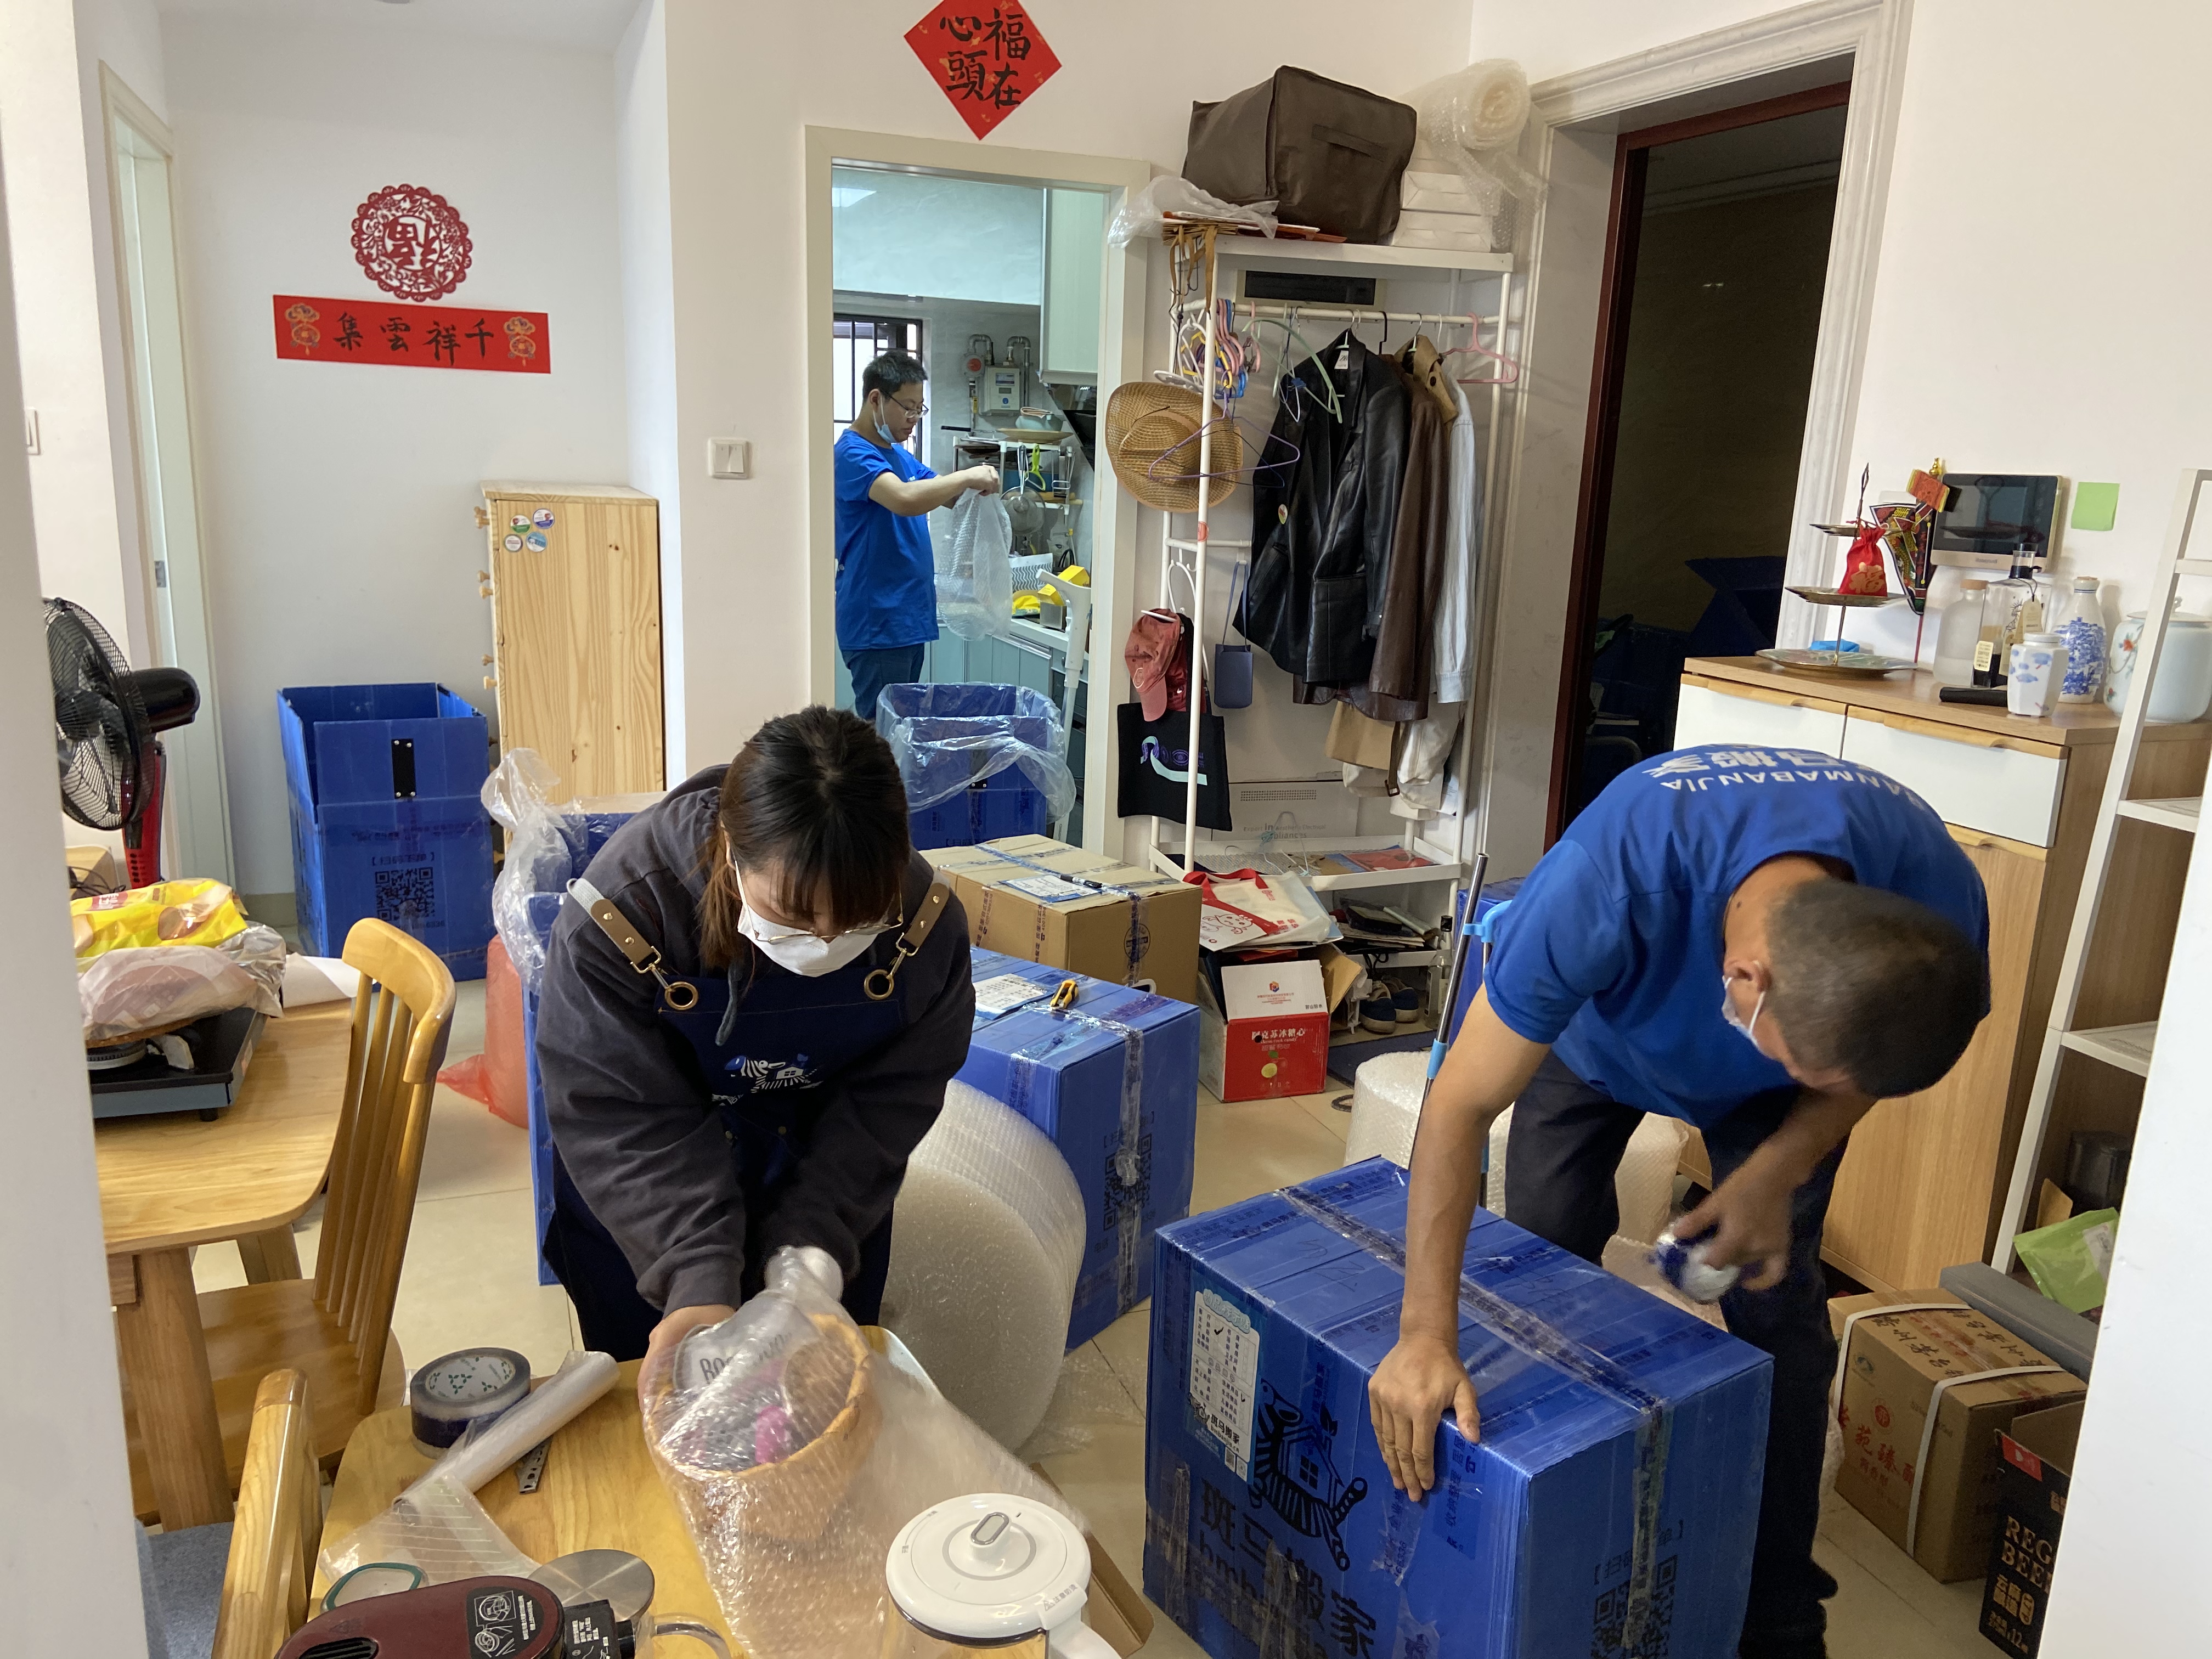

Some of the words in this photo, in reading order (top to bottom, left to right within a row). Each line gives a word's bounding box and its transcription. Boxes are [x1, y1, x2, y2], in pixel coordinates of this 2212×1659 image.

[1211, 1413, 1240, 1446] 斑马搬家
[1053, 1583, 1079, 1604] 注意防烫
